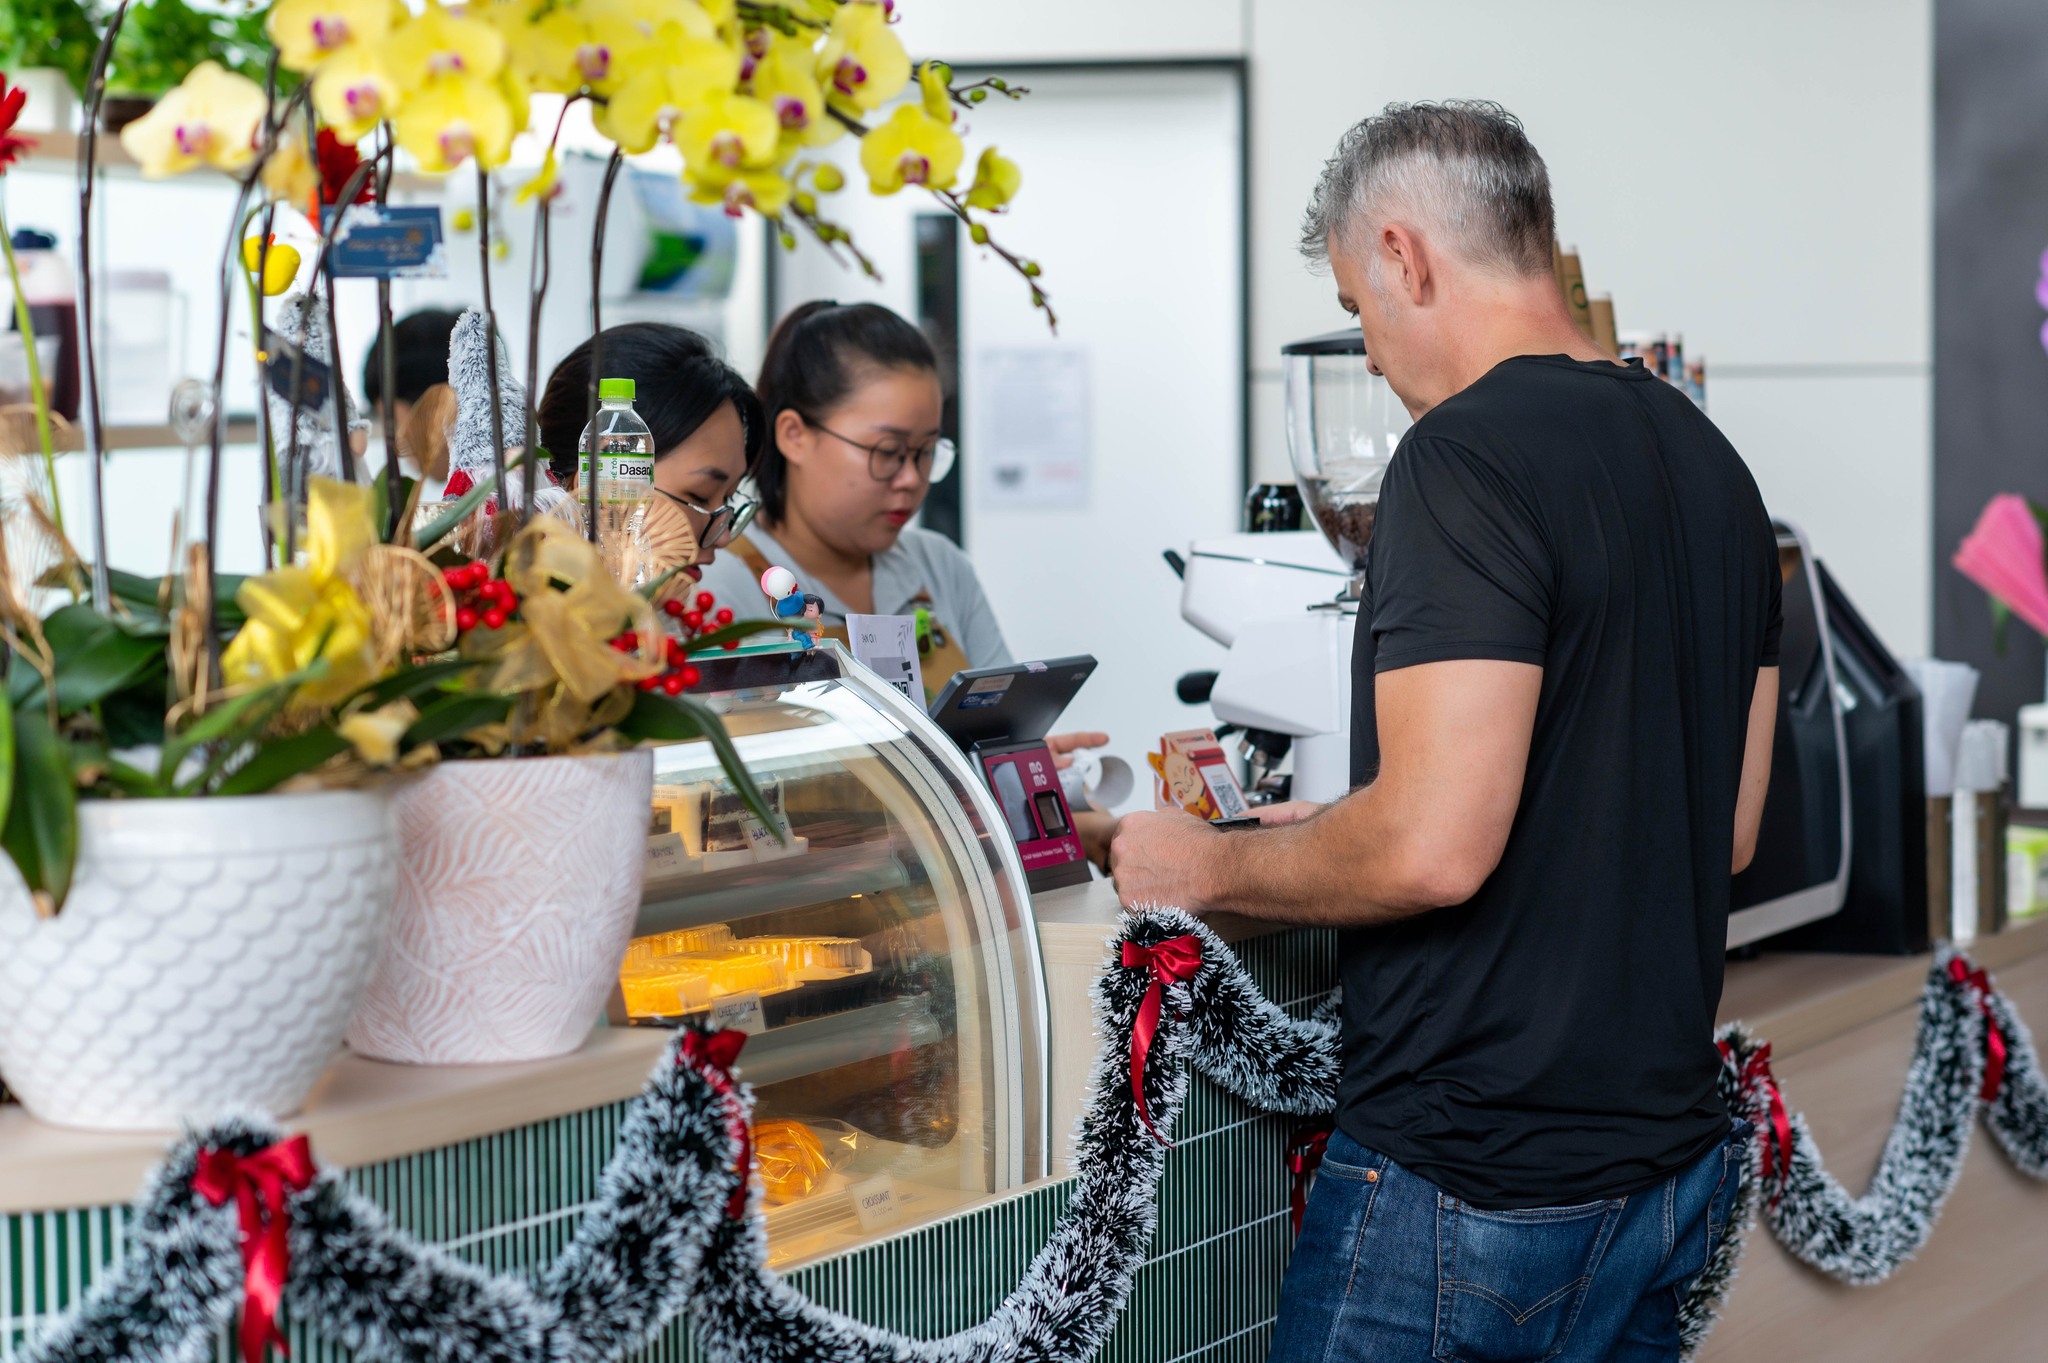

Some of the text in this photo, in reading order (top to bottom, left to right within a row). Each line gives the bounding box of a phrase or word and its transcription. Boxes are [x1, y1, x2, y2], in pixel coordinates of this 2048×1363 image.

[619, 463, 652, 475] Dasan
[752, 827, 769, 841] BLACK
[862, 1190, 890, 1210] CROISSANT
